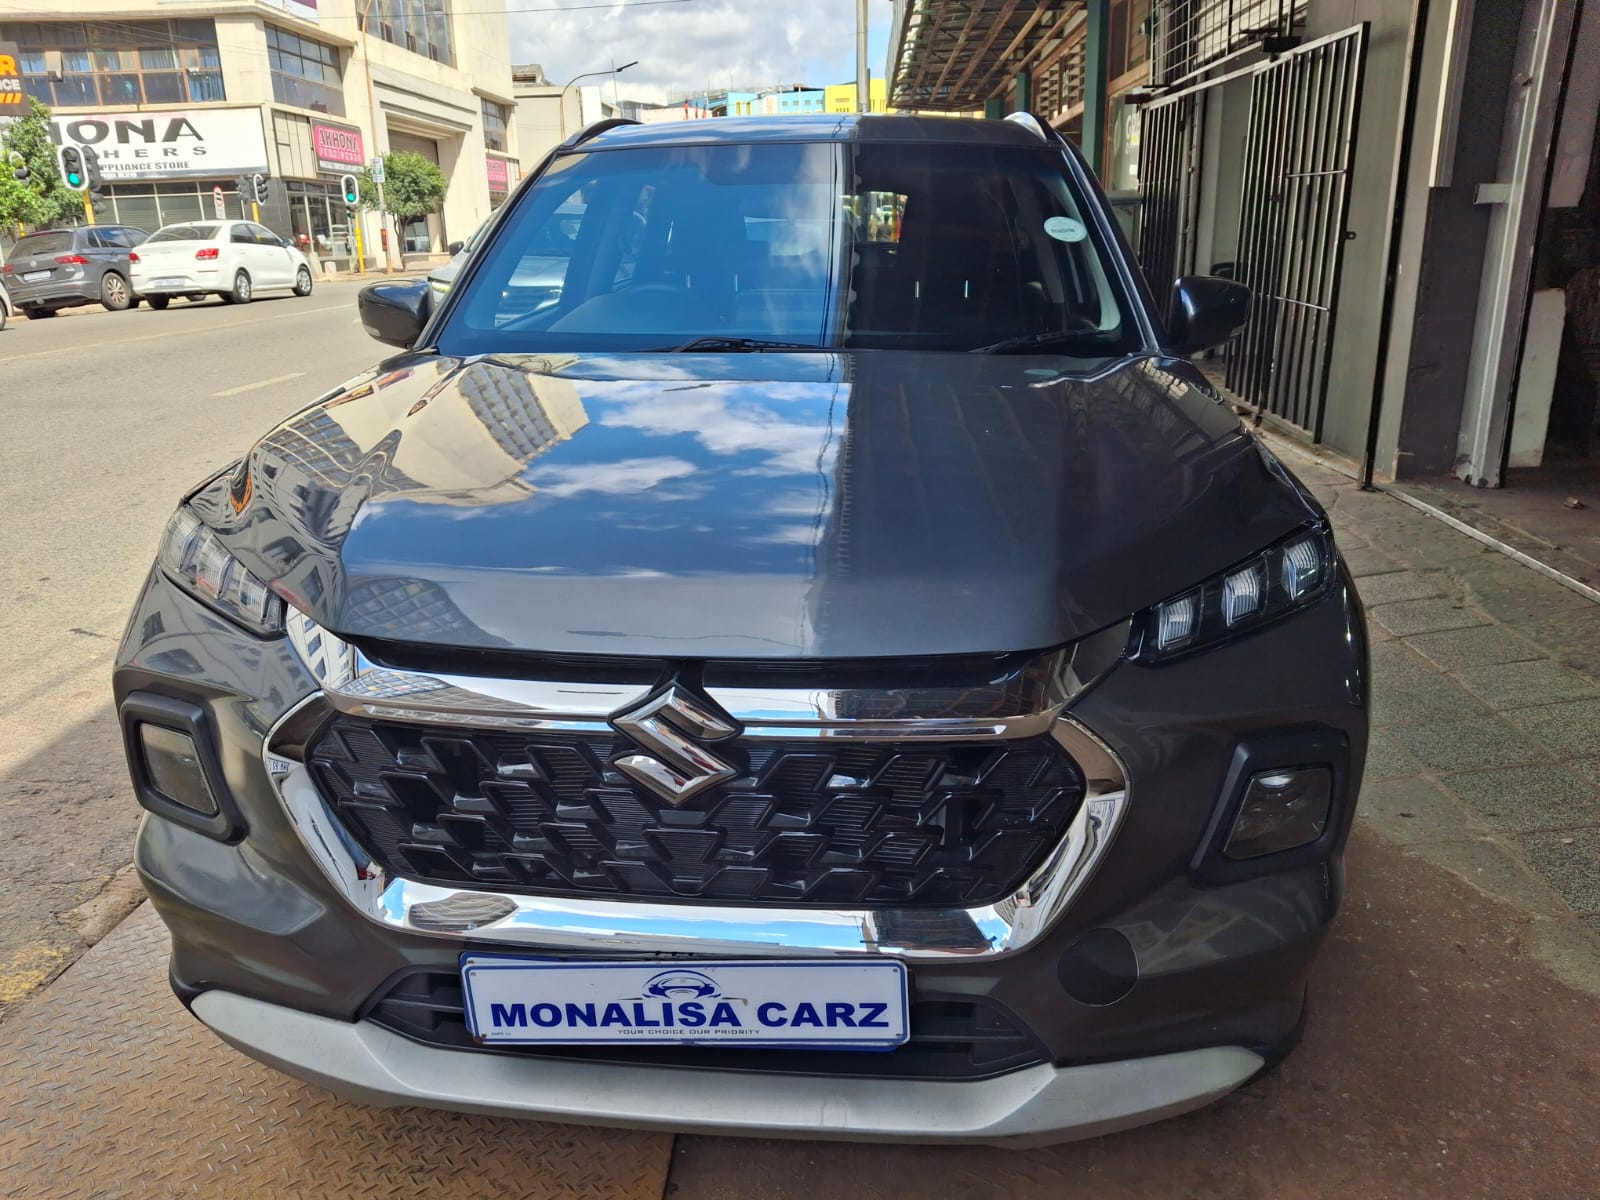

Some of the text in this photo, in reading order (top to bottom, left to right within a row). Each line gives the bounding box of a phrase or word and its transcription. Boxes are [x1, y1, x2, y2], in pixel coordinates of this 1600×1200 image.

[319, 128, 359, 151] AKHONA
[155, 161, 190, 170] STORE
[490, 1002, 889, 1027] MONALISA CARZ
